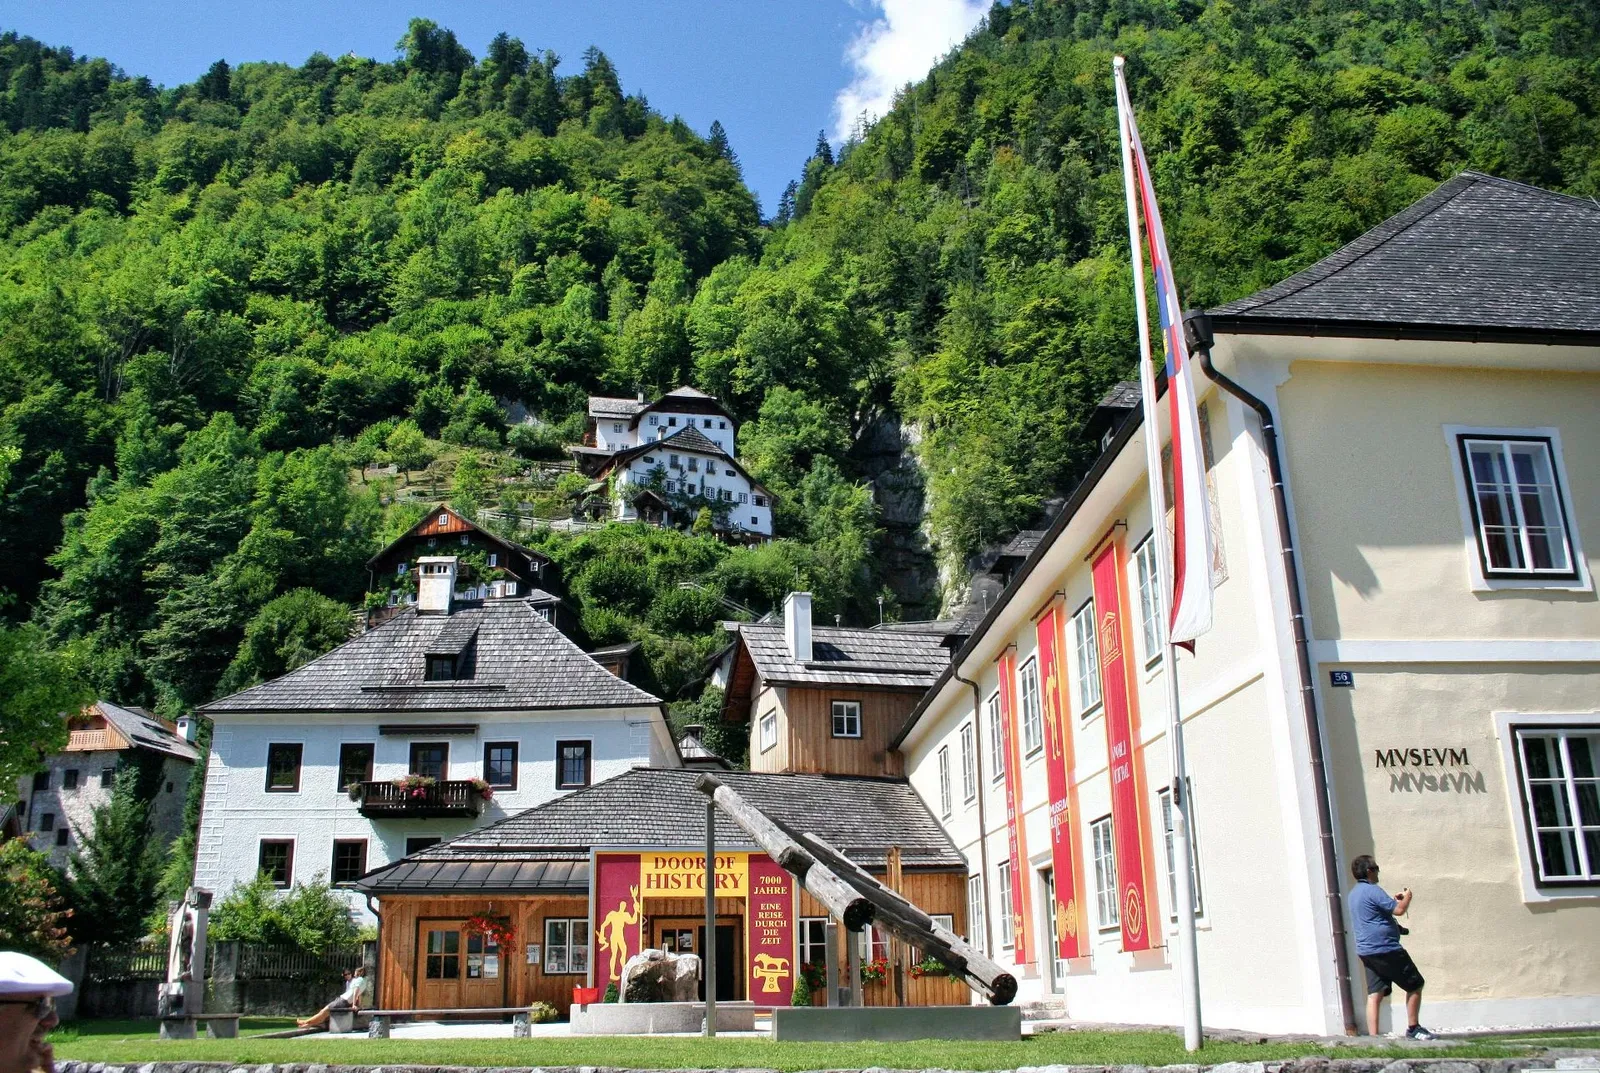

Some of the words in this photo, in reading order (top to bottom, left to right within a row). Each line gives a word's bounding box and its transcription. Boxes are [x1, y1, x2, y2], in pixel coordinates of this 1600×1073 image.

[1334, 672, 1348, 682] 56
[1375, 747, 1470, 768] MVSEVM
[654, 856, 707, 870] DOOR
[714, 856, 736, 870] OF
[646, 873, 744, 890] HISTORY
[759, 876, 782, 885] 7000
[753, 886, 788, 895] JAHRE
[760, 903, 782, 911] EINE
[758, 911, 784, 919] REISE
[755, 920, 787, 928] DURCH
[763, 928, 779, 936] DIE
[760, 937, 782, 945] ZEIT
